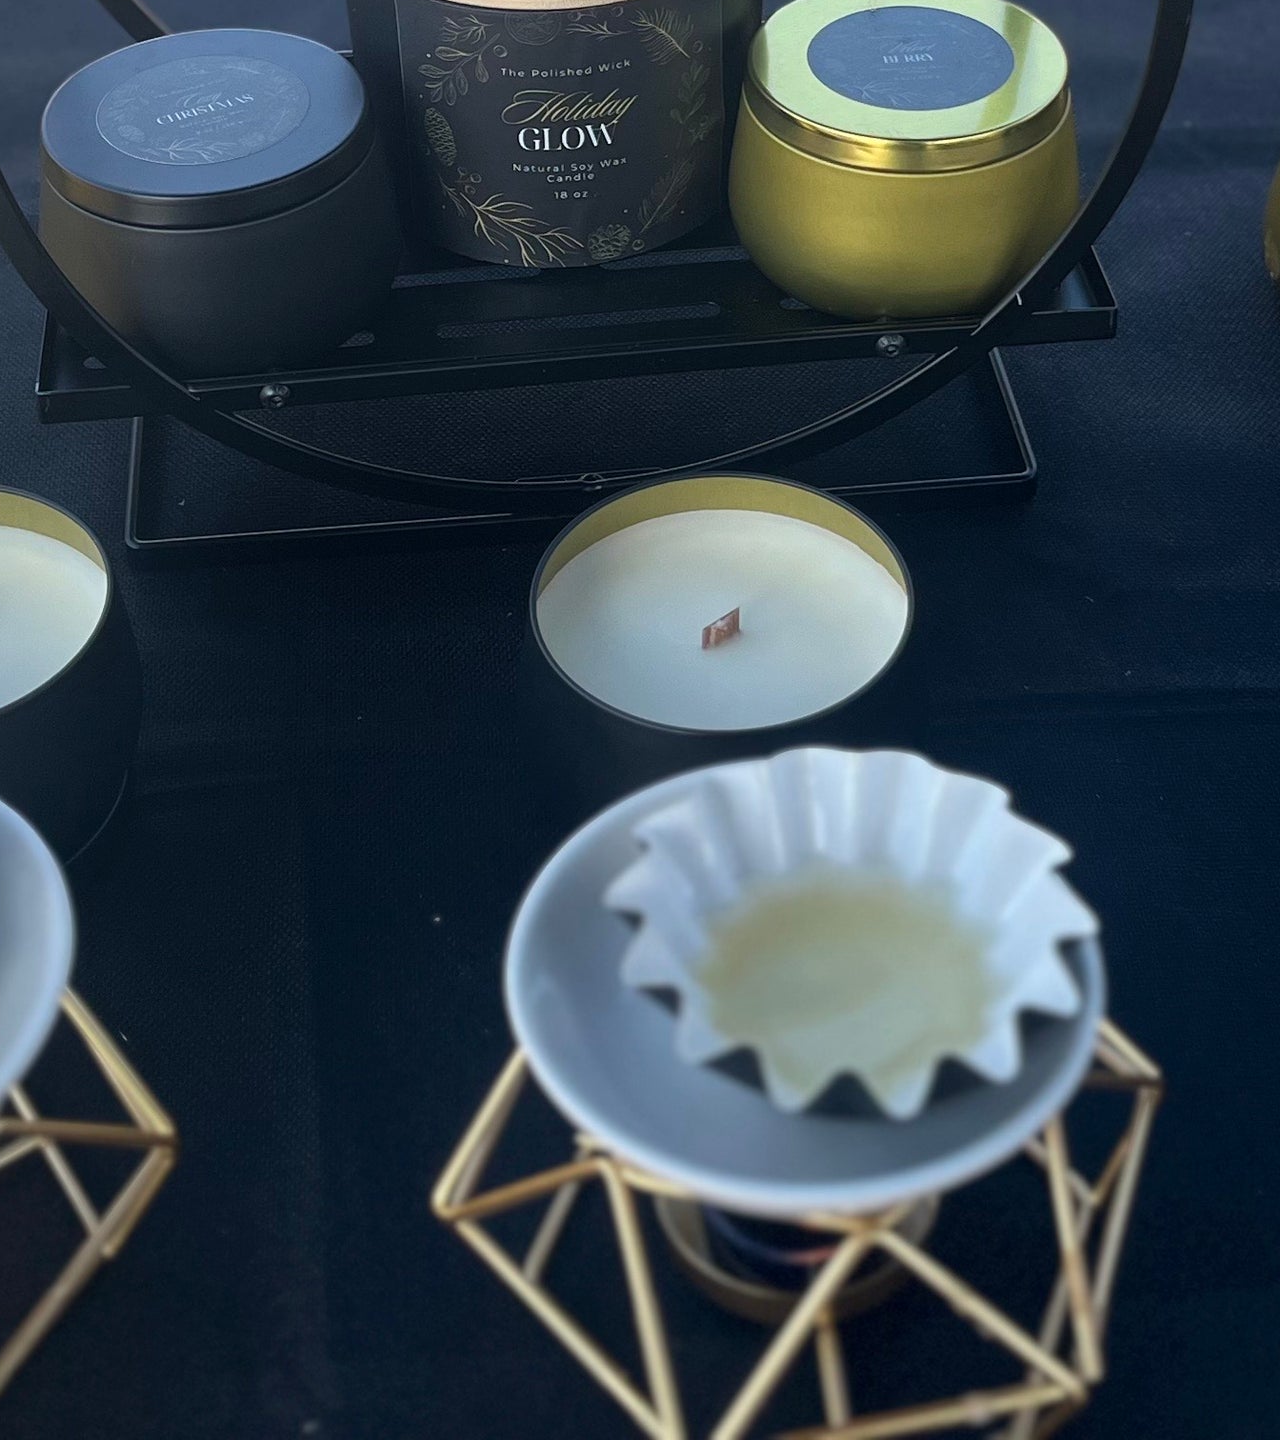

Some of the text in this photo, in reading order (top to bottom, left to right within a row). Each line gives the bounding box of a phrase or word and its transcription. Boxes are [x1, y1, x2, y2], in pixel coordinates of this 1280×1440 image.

[501, 59, 632, 78] The Polished Wick
[156, 93, 255, 125] CHRISTMAS
[501, 88, 639, 128] Holiday
[517, 121, 619, 152] GLOW
[512, 157, 627, 173] Natural Soy Wax
[546, 172, 595, 183] Candle
[573, 191, 589, 199] oz
